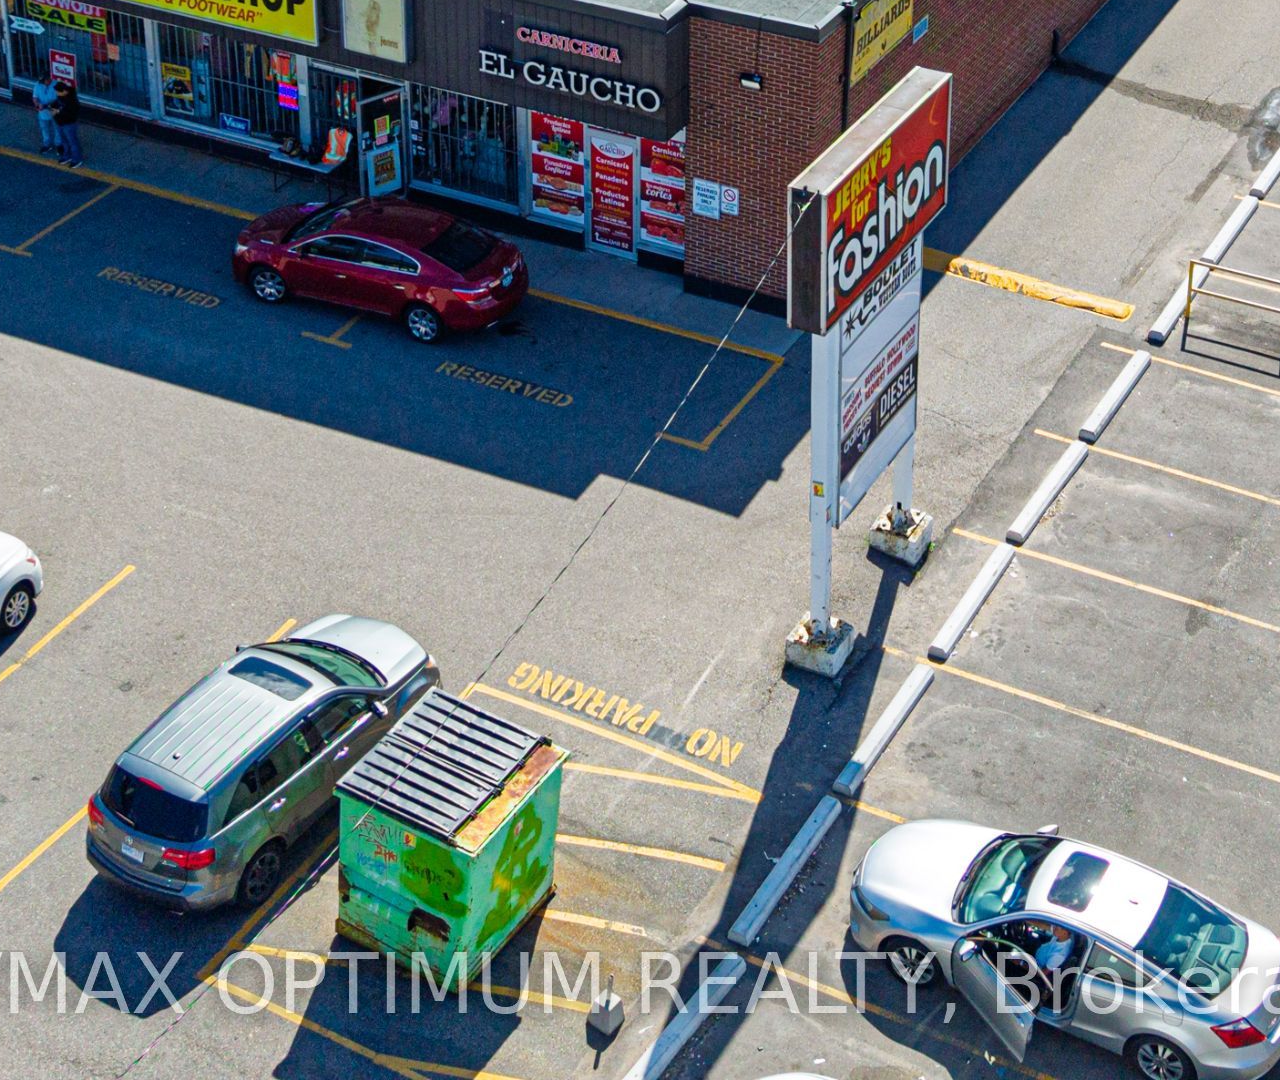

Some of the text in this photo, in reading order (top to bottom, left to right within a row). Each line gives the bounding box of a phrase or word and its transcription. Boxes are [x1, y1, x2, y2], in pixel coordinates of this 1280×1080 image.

[28, 2, 105, 33] SALE
[516, 26, 622, 64] CARNICERIA
[479, 50, 661, 113] EL GAUCHO
[833, 137, 892, 222] JERRY'S
[851, 192, 870, 229] for
[96, 266, 220, 308] RESERVED
[863, 238, 917, 309] BOULET
[434, 360, 574, 407] RESERVED
[880, 363, 915, 420] DIESEL
[843, 410, 872, 454] adidas
[507, 662, 744, 767] NO PARKING
